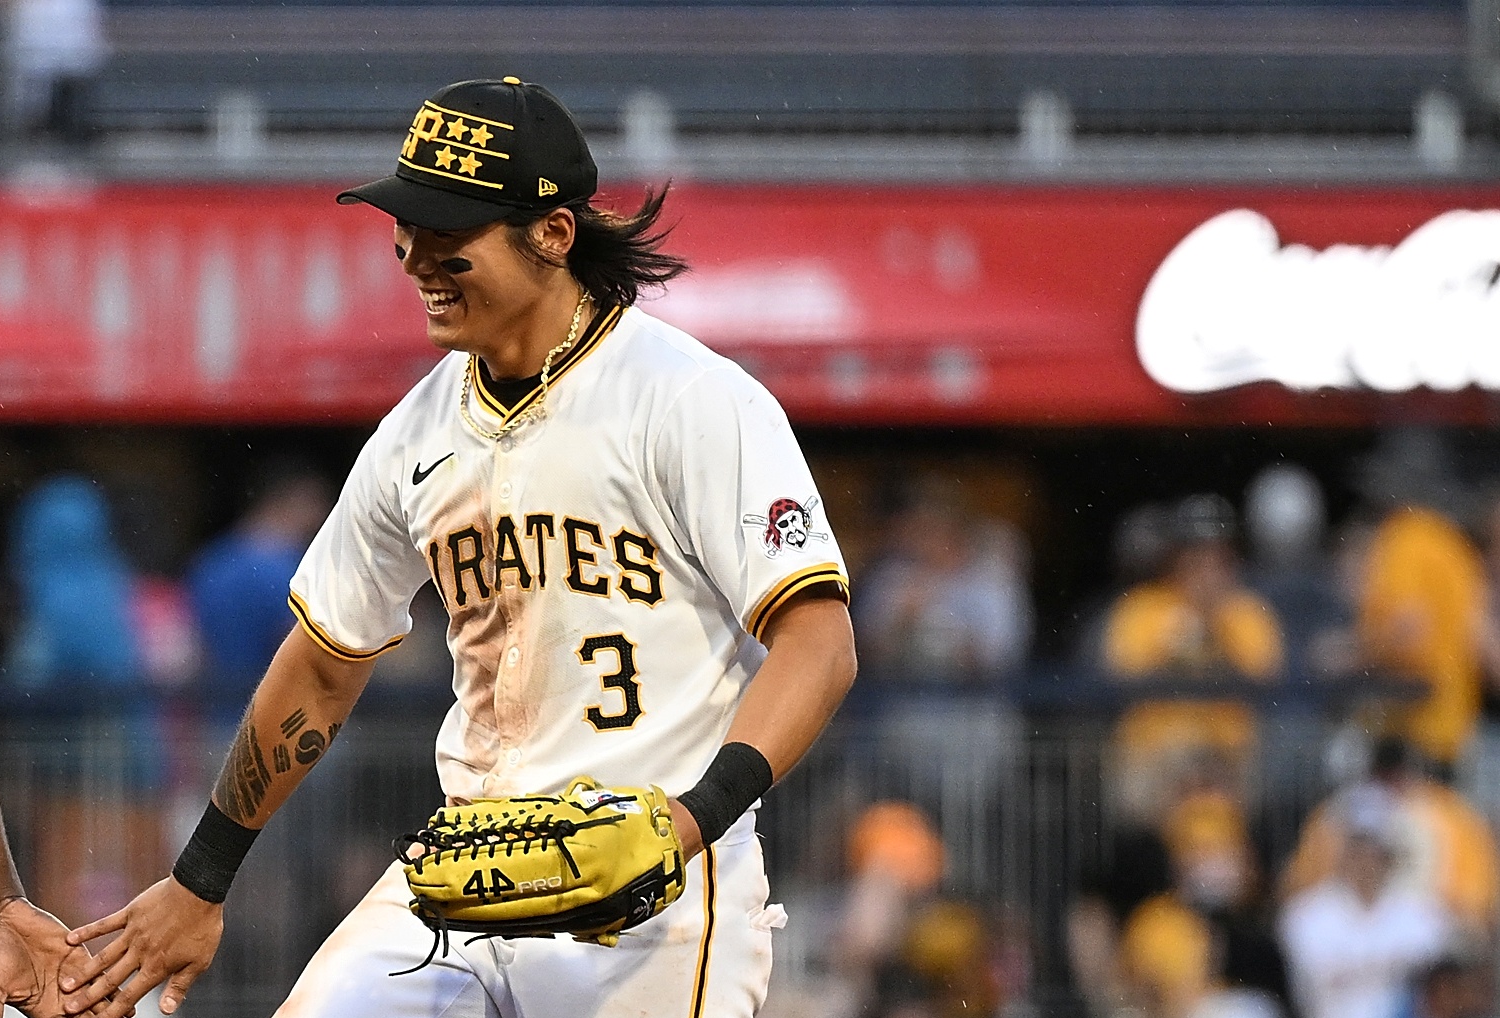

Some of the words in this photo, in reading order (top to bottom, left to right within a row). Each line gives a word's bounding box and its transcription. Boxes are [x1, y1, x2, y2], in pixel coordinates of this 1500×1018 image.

[425, 511, 667, 610] IRATES
[574, 631, 647, 733] 3
[518, 876, 563, 894] PRO
